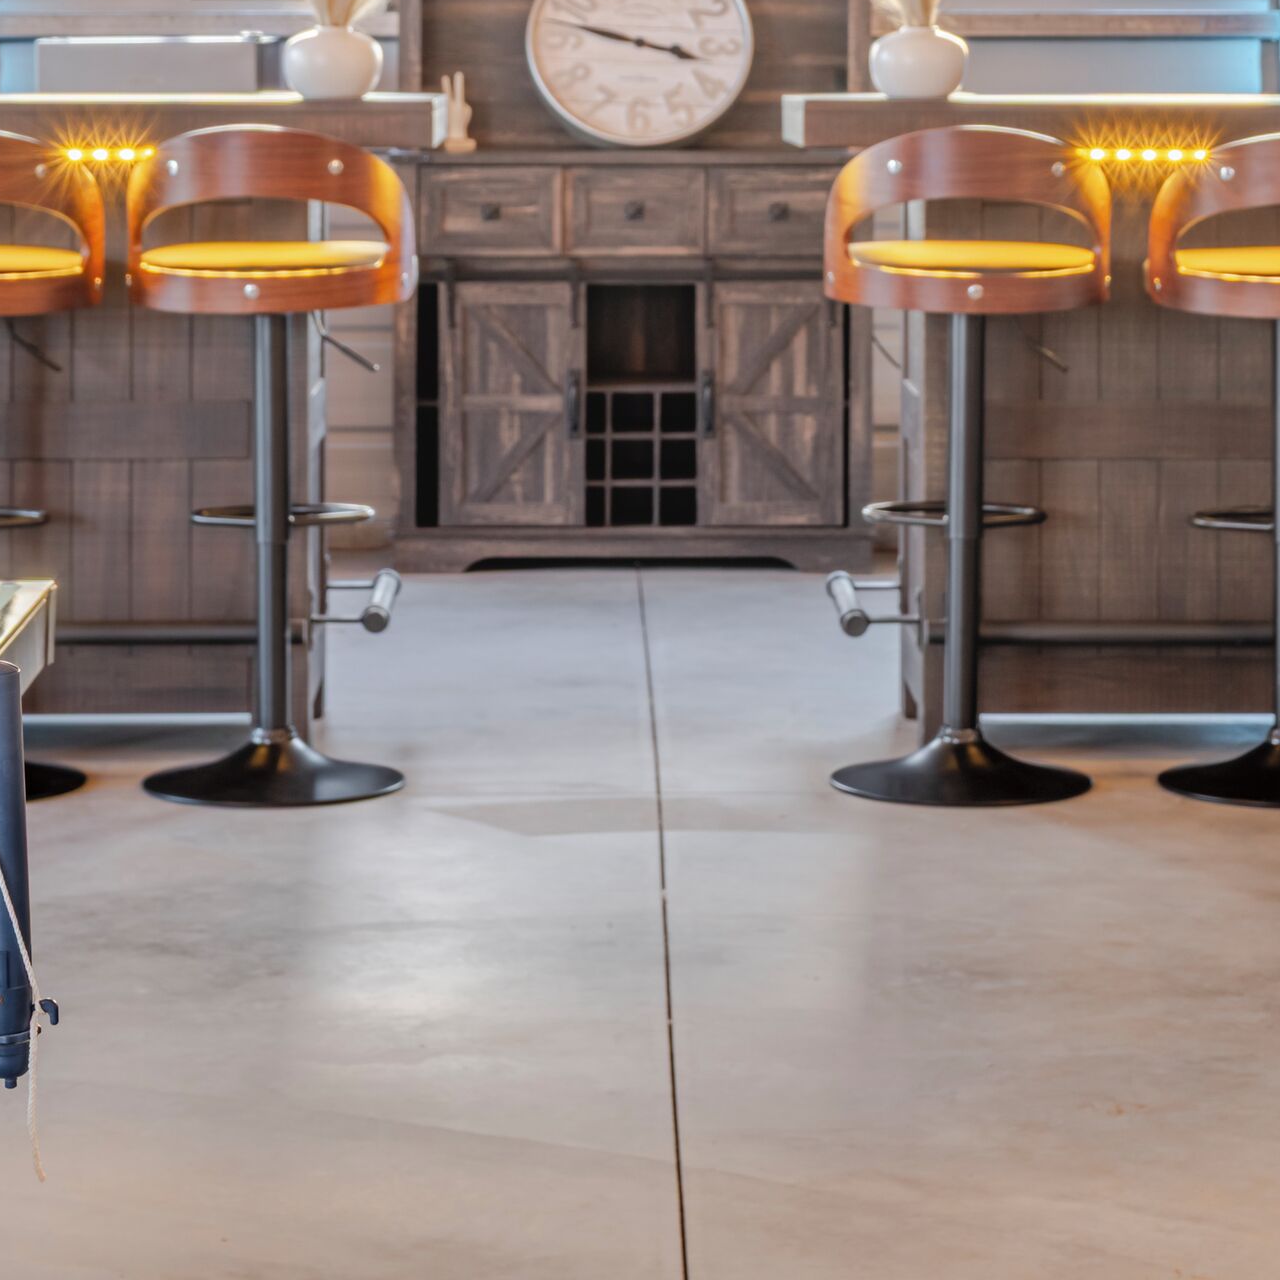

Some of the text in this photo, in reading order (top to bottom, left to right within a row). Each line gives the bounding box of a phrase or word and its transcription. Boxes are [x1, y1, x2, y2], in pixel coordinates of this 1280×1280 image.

[543, 31, 583, 51] 9
[699, 36, 740, 57] 3
[551, 63, 593, 90] 8
[690, 67, 728, 100] 4
[587, 84, 619, 117] 7
[627, 96, 652, 132] 6
[663, 82, 695, 127] 5
